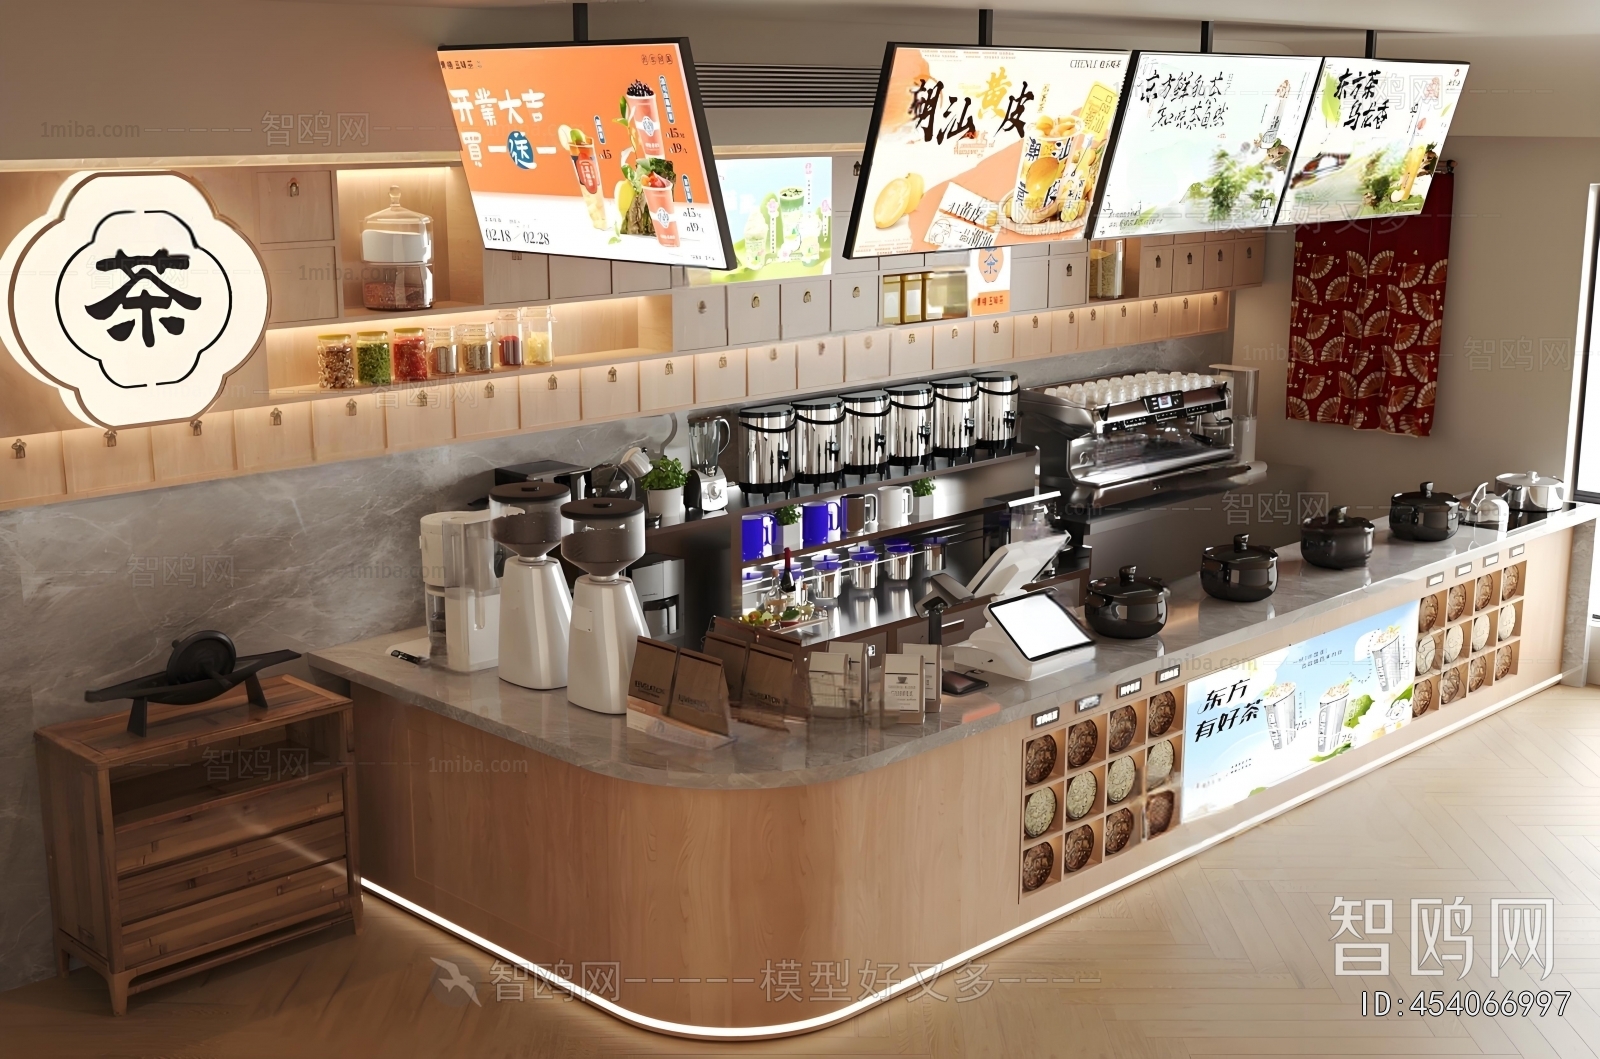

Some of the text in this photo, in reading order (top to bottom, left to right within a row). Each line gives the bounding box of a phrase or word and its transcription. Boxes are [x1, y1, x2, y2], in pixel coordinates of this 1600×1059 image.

[85, 247, 202, 349] 茶
[1198, 678, 1251, 714] 东方
[1195, 699, 1264, 743] 有好茶
